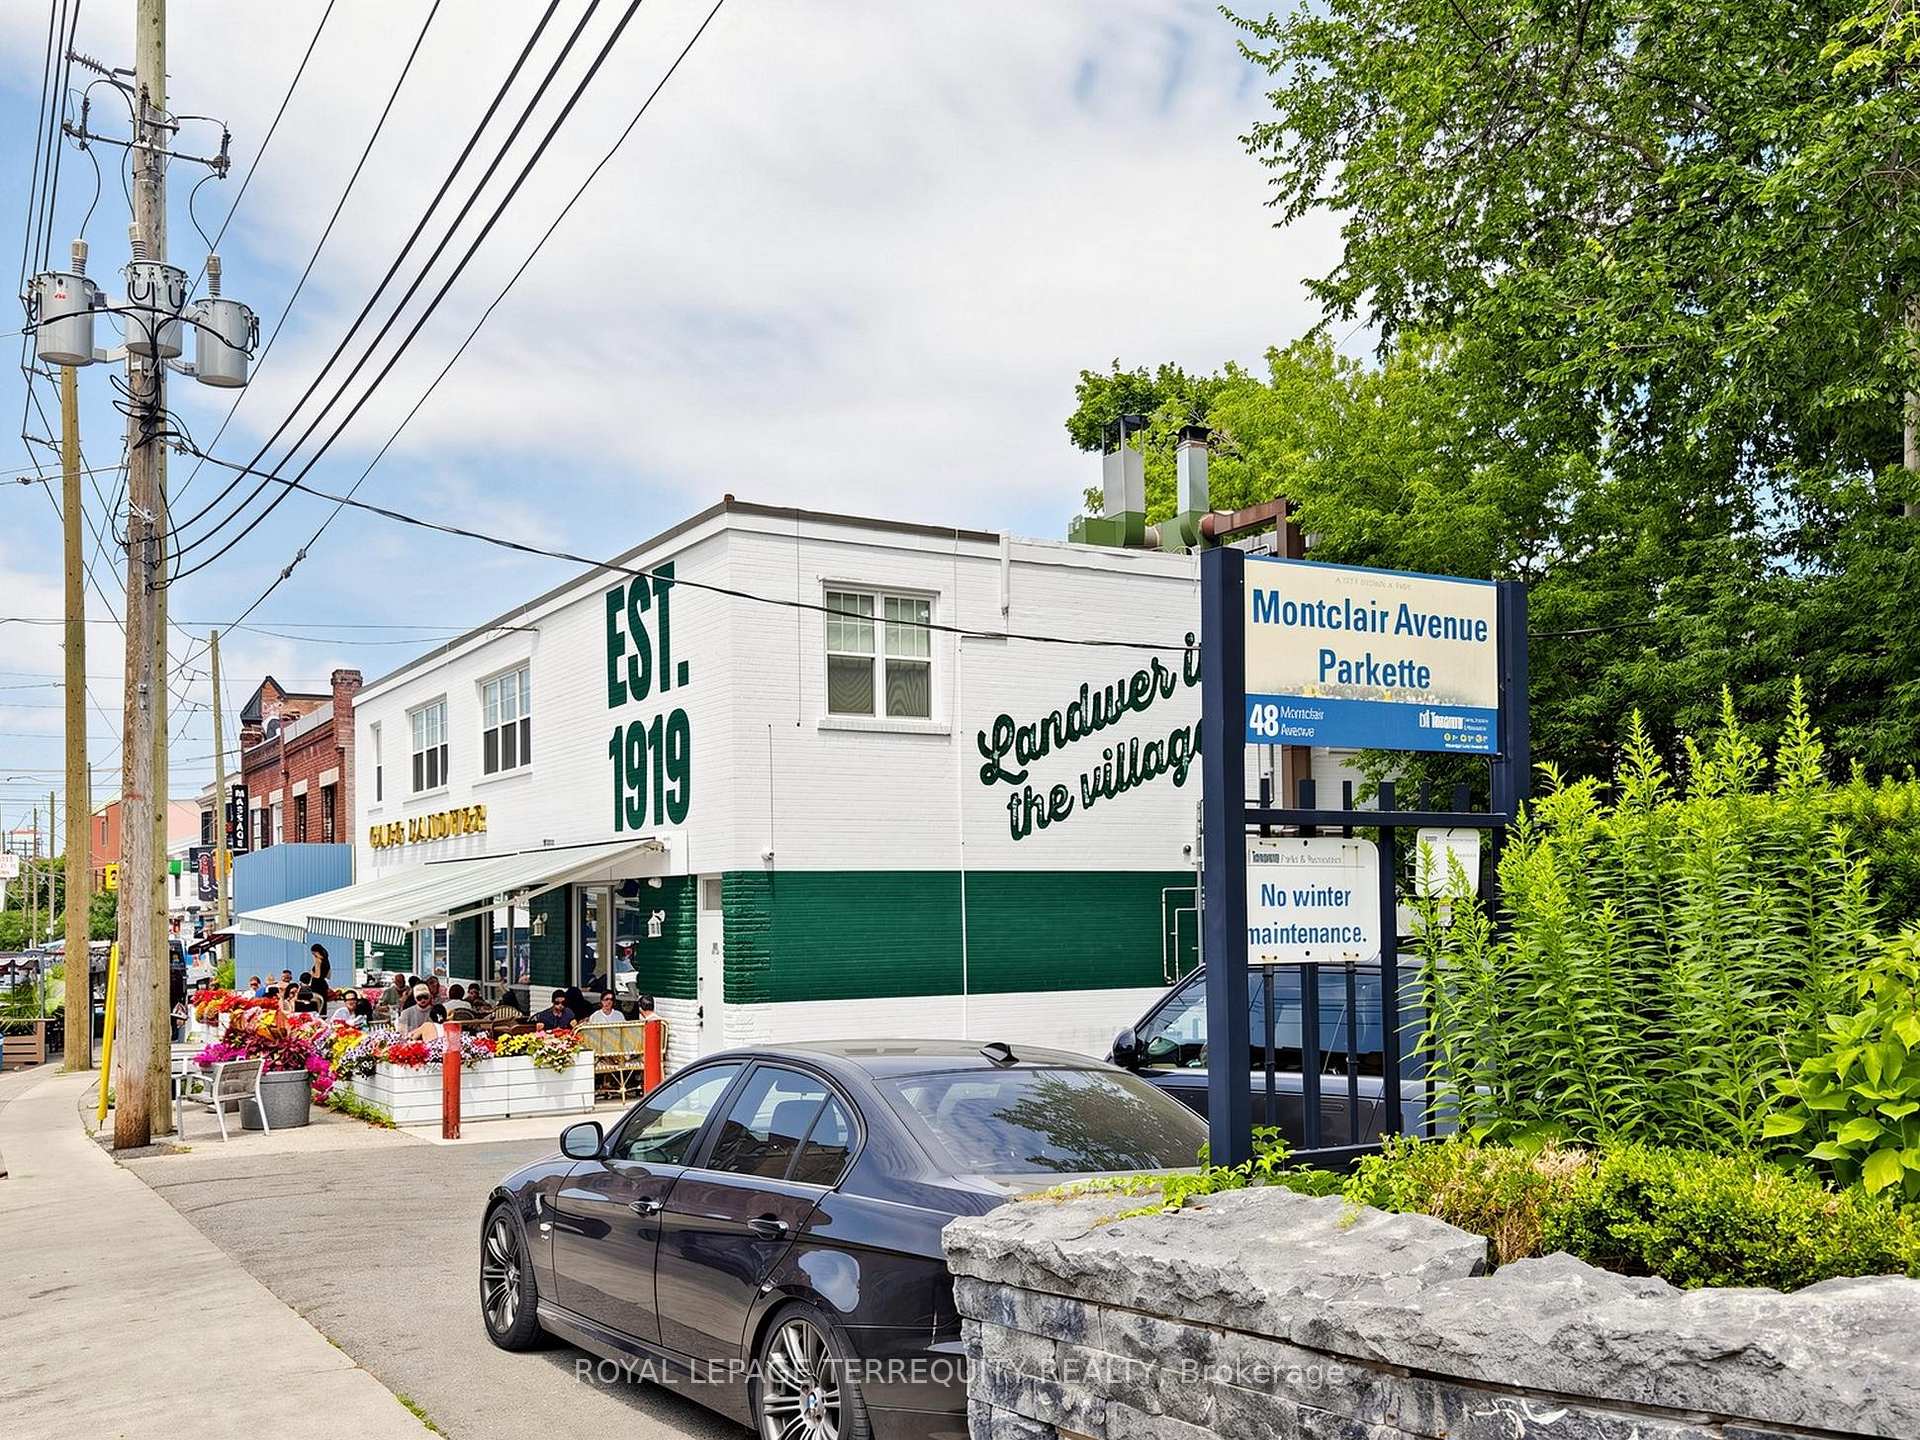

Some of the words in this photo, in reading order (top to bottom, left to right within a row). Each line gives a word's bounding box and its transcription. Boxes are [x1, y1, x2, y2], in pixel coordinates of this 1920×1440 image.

[605, 560, 689, 709] EST.
[1252, 588, 1389, 634] Montclair
[1394, 603, 1488, 643] Avenue
[1318, 648, 1432, 690] Parkette
[977, 656, 1176, 785] Landwer
[1249, 703, 1279, 737] 48
[608, 708, 691, 832] 1919
[234, 789, 245, 848] MASSAGE
[1007, 785, 1075, 841] the
[1261, 883, 1287, 907] No
[1293, 883, 1352, 907] winter
